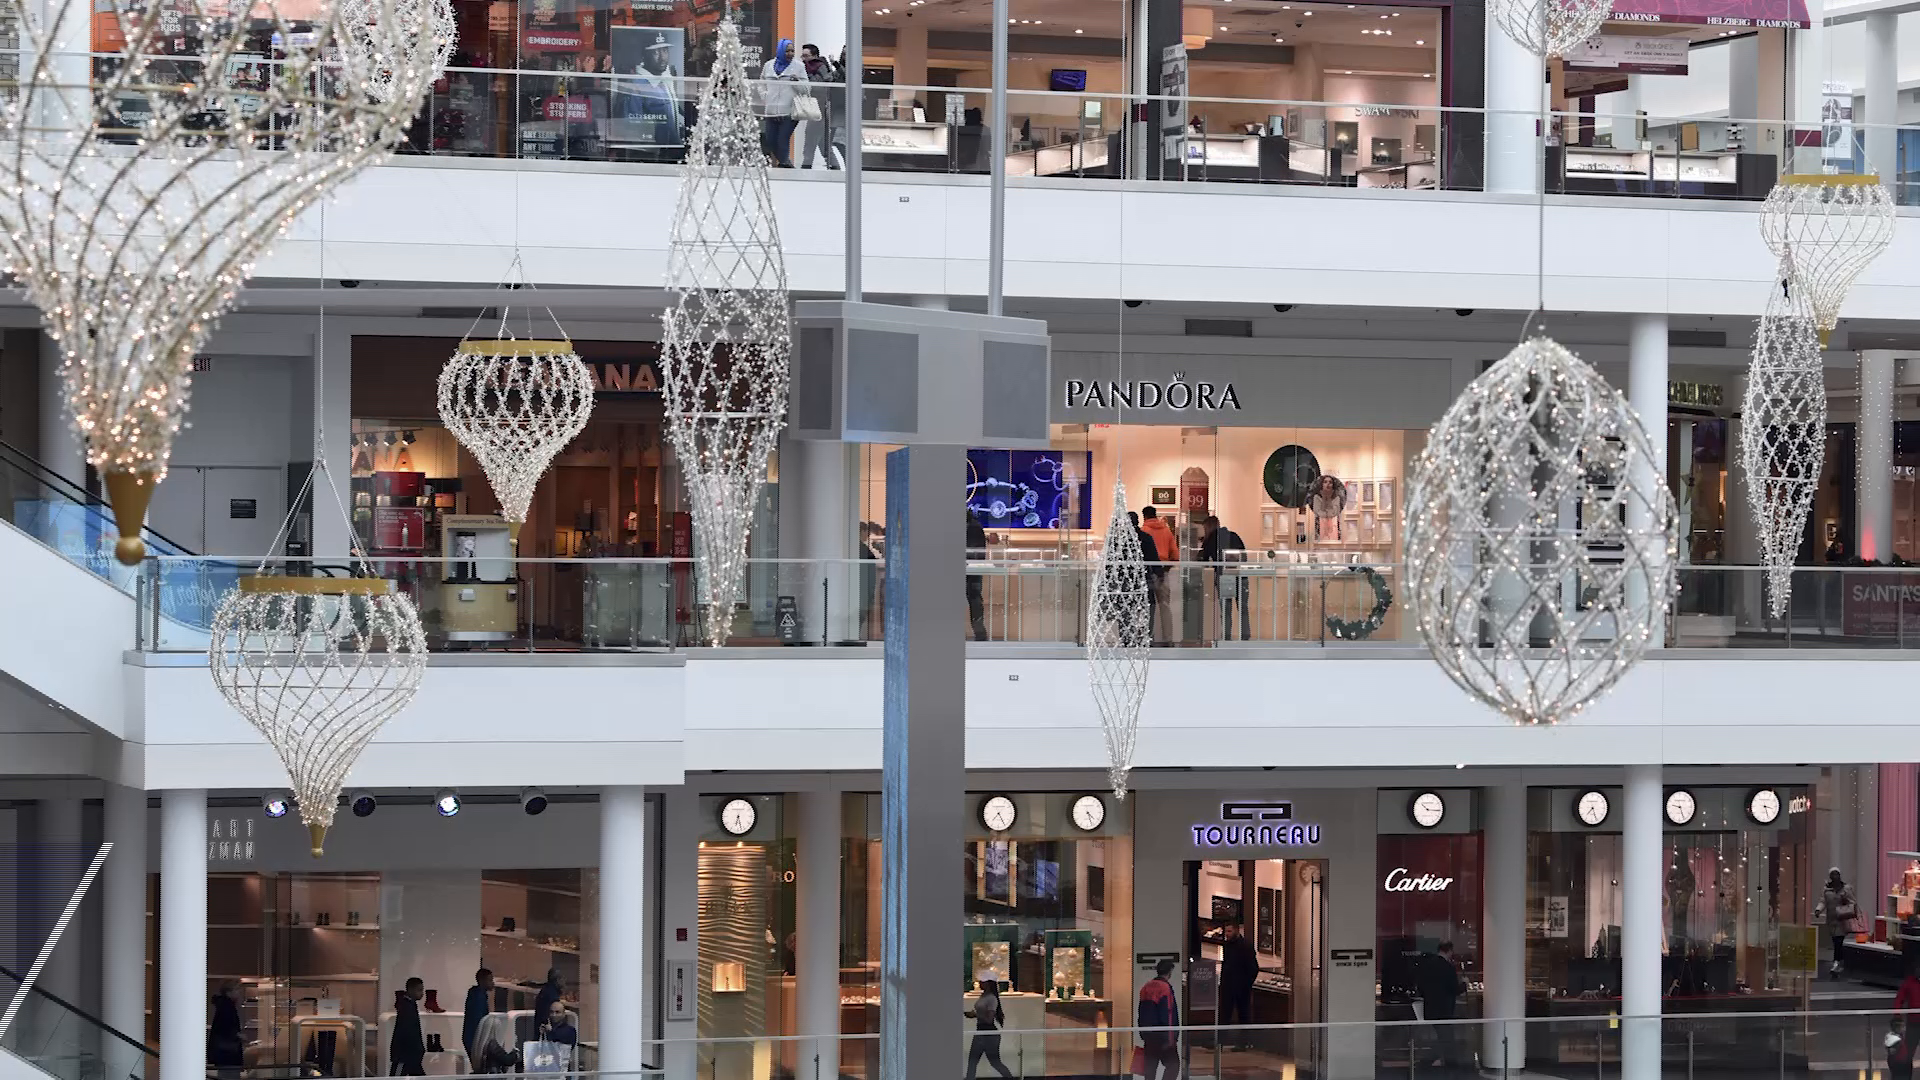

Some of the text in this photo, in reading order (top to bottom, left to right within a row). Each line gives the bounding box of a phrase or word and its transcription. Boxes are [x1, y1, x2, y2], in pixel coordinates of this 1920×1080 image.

[1615, 12, 1660, 21] DIAMONDS
[1707, 16, 1801, 28] HELZBERG DIAMONDS
[528, 36, 579, 46] EMBROIDERY
[549, 102, 587, 110] STOKING
[549, 110, 587, 118] STUFERS
[193, 357, 212, 371] EXIT
[1066, 376, 1242, 410] PANDORA
[1192, 825, 1321, 846] TOURNEAU
[1384, 867, 1454, 892] Cartier
